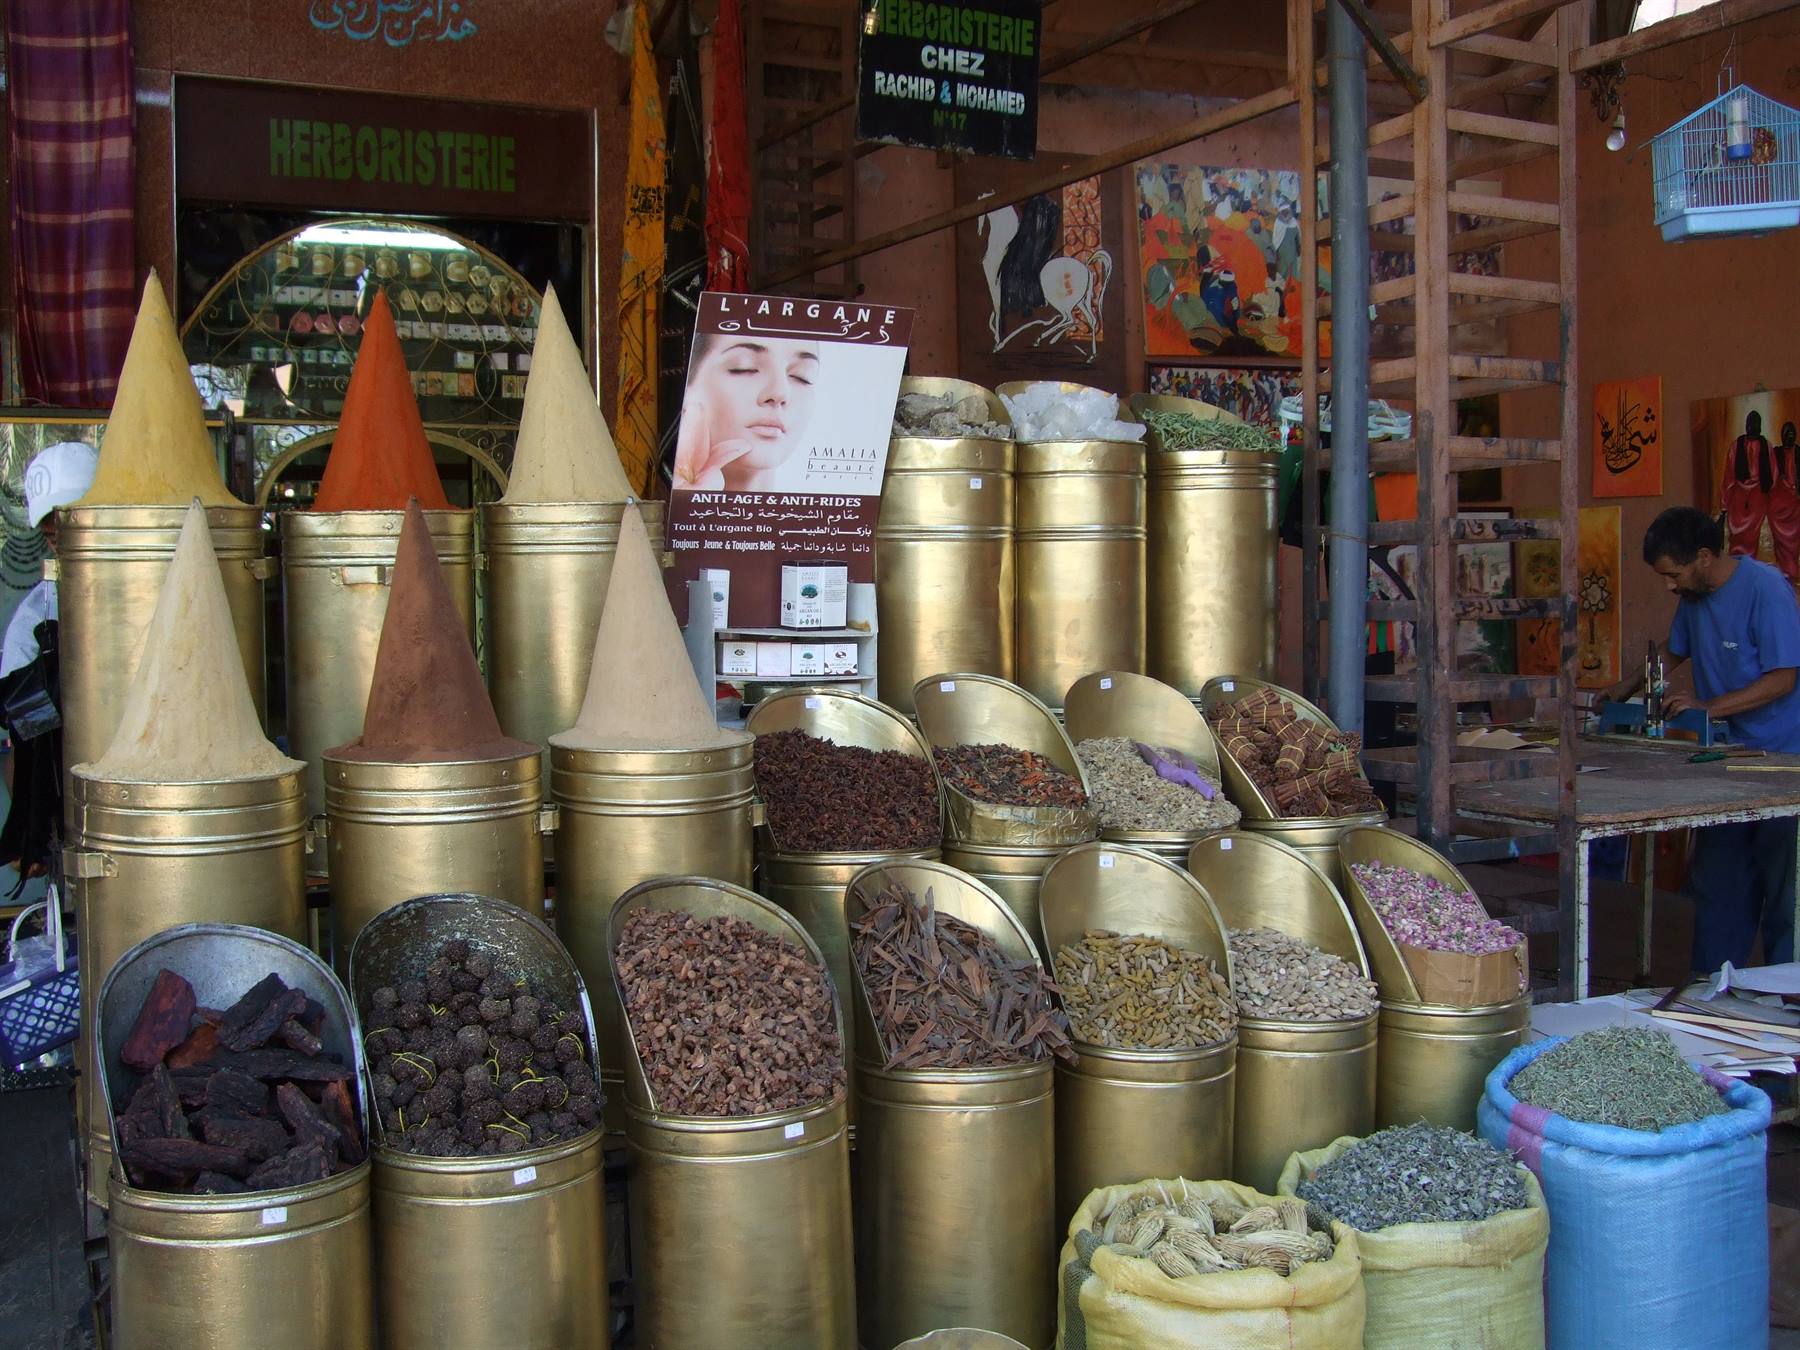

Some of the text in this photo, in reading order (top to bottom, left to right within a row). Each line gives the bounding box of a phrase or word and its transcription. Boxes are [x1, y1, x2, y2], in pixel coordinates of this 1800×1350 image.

[920, 45, 985, 77] CHEZ
[874, 70, 1026, 116] RACHID & MOHAMED
[269, 117, 517, 193] HERBORISTERIE
[719, 296, 896, 325] L'ARGANE
[809, 446, 877, 460] AMALIA
[807, 460, 874, 473] beauté
[691, 493, 862, 508] ANTI-AGE & ANTI-RIDES
[758, 508, 823, 522] الشيخوخة
[827, 509, 860, 525] مقاوم
[673, 523, 773, 534] Tout à L'argane Bio
[778, 526, 830, 537] الطبيعي
[672, 538, 775, 552] Toujours Jeune & Toujours Belle
[780, 540, 802, 553] جميلة
